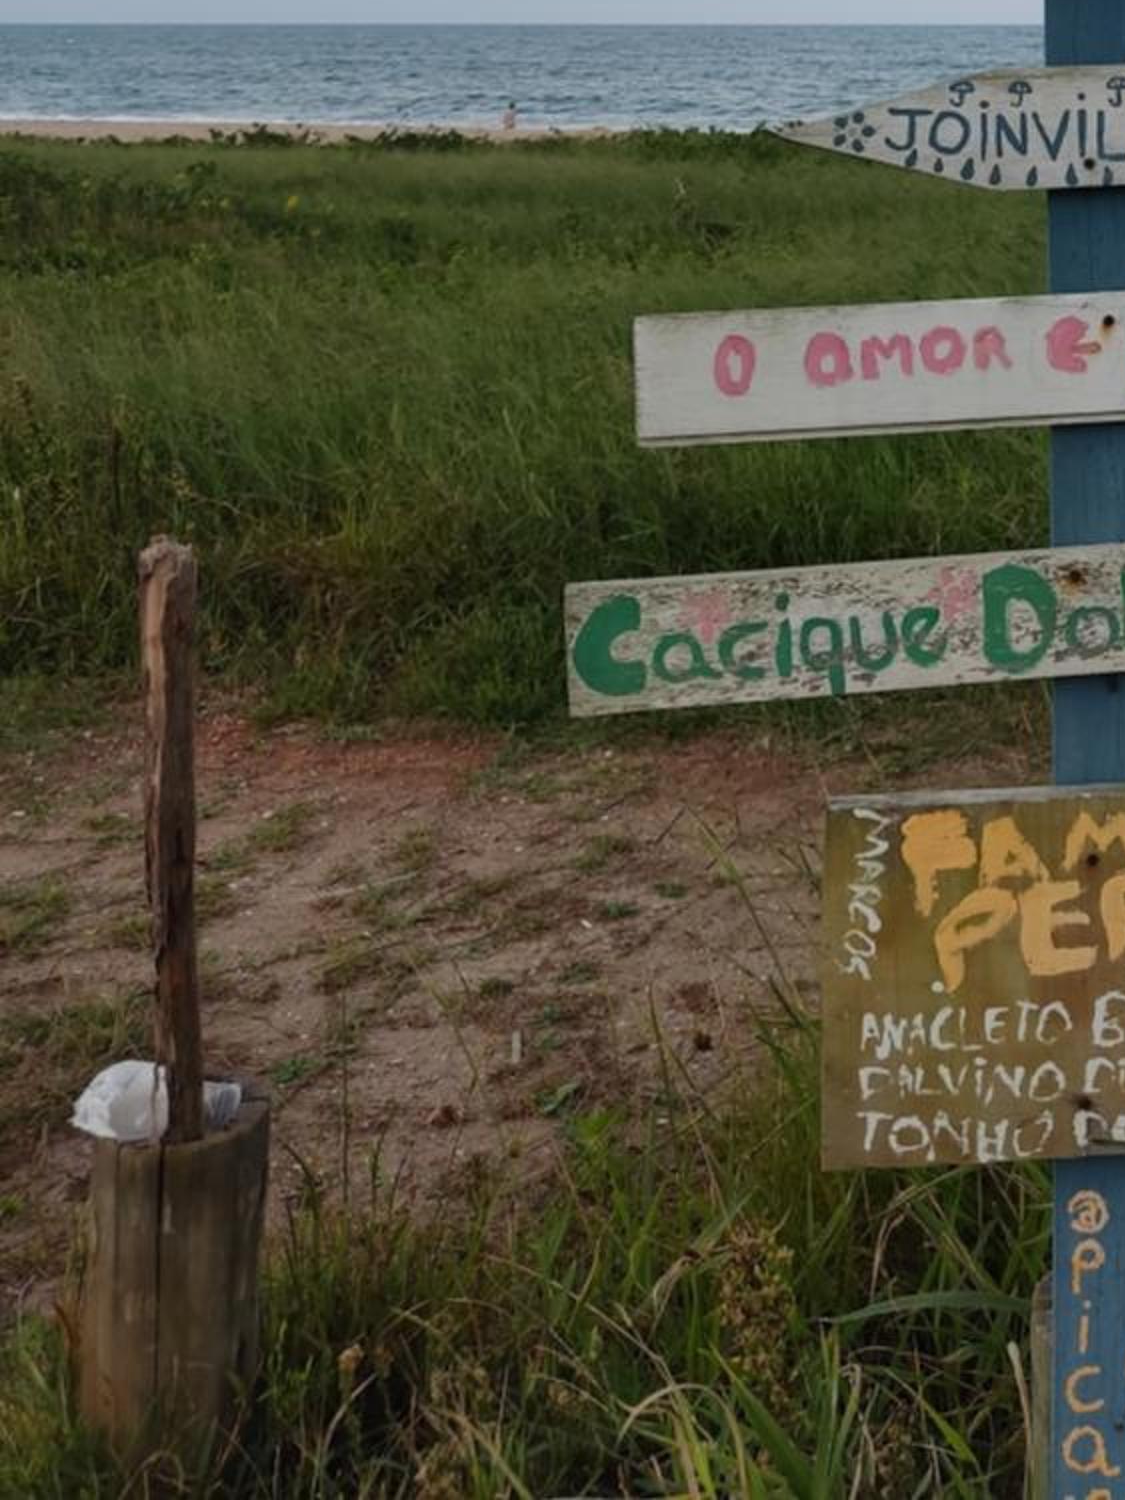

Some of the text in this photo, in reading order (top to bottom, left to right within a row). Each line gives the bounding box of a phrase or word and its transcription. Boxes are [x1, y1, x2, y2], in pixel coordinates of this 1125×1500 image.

[713, 334, 756, 396] O
[572, 593, 948, 698] Cacique
[857, 1110, 1055, 1163] TONHO
[1061, 1190, 1121, 1500] @pica
